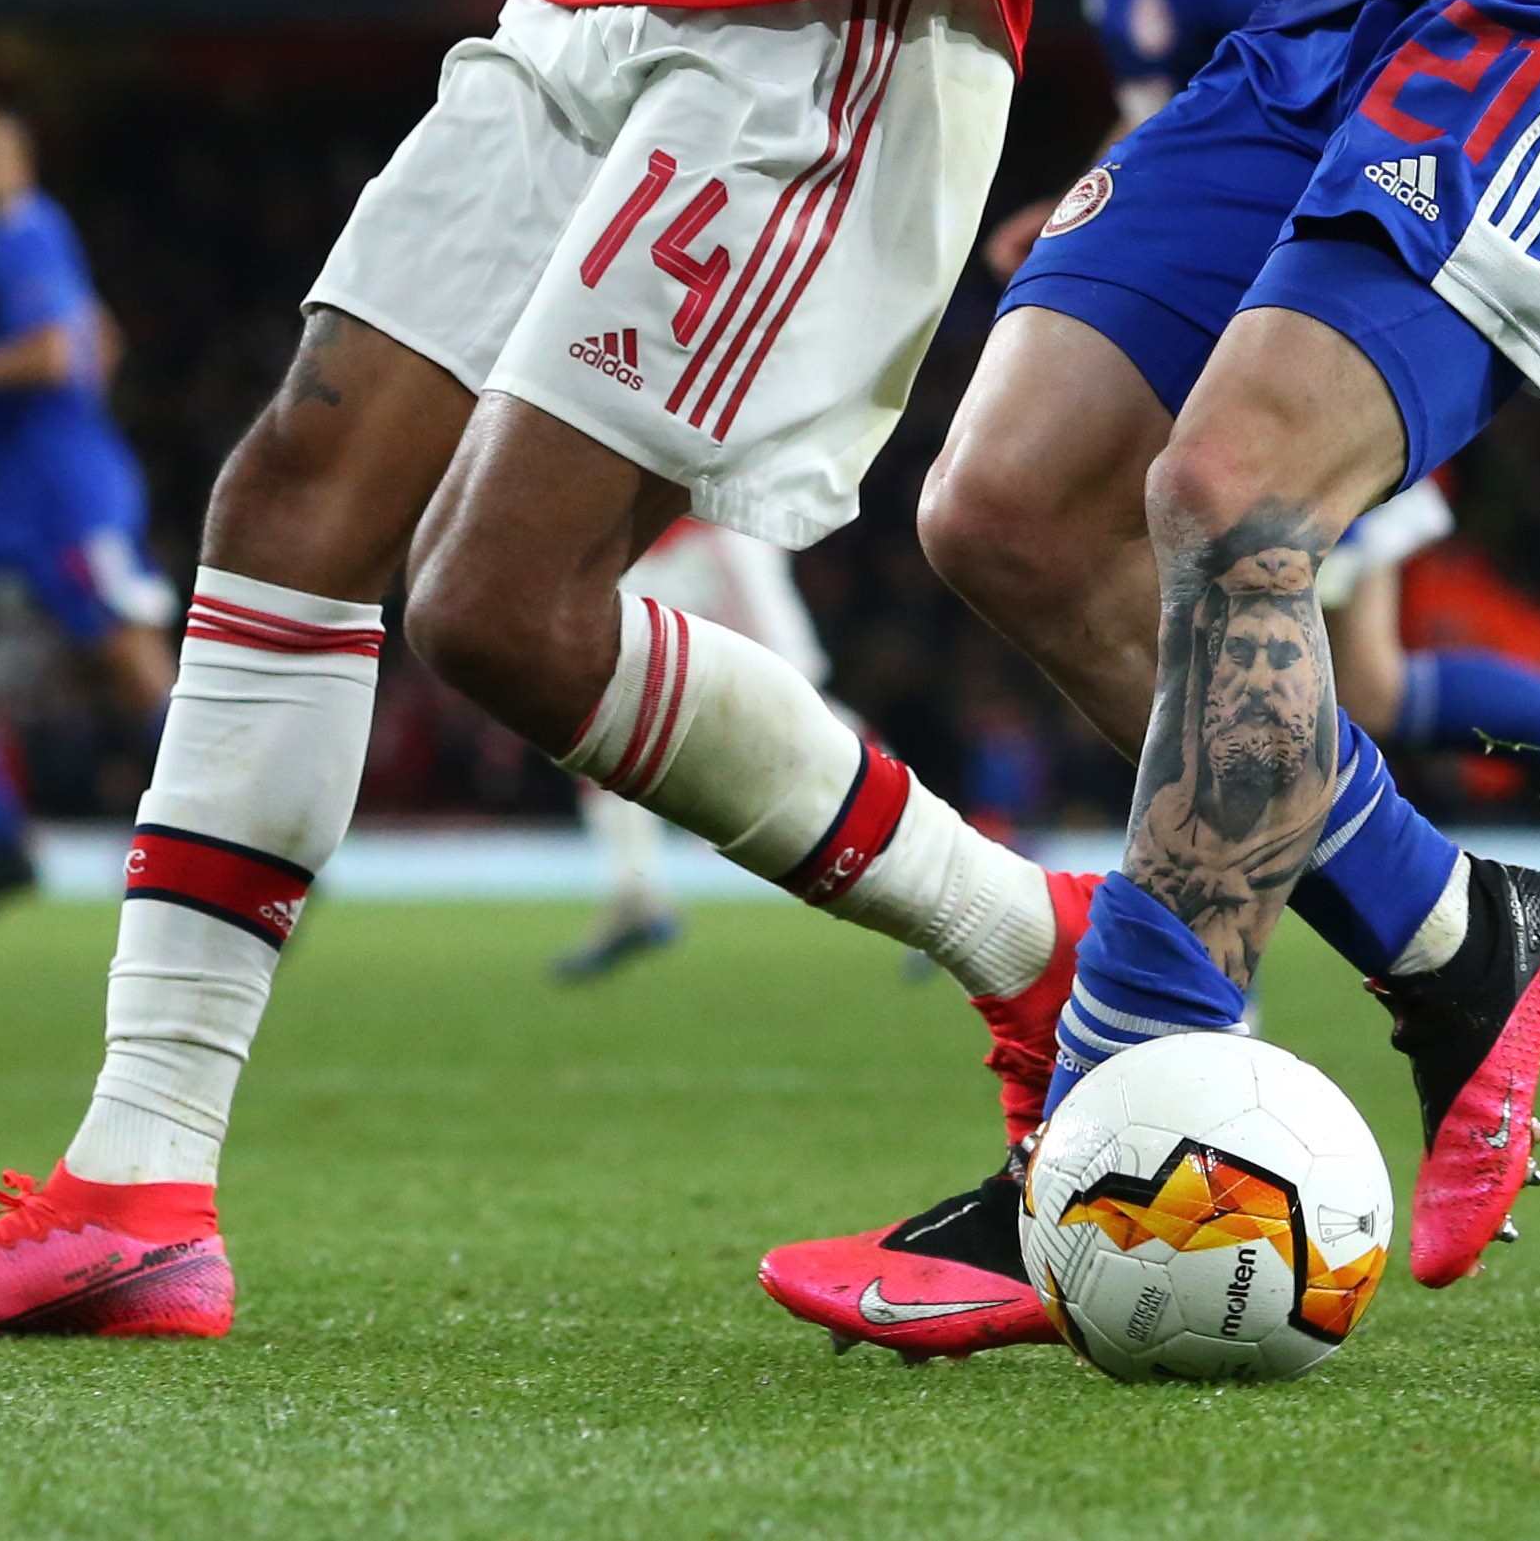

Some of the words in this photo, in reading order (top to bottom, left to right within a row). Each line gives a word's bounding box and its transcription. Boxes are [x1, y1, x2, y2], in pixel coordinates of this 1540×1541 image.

[1363, 158, 1441, 222] adidas
[580, 149, 731, 347] 14
[569, 338, 645, 392] adidas
[1126, 1285, 1157, 1339] OFFICIAL
[1220, 1248, 1258, 1337] molten
